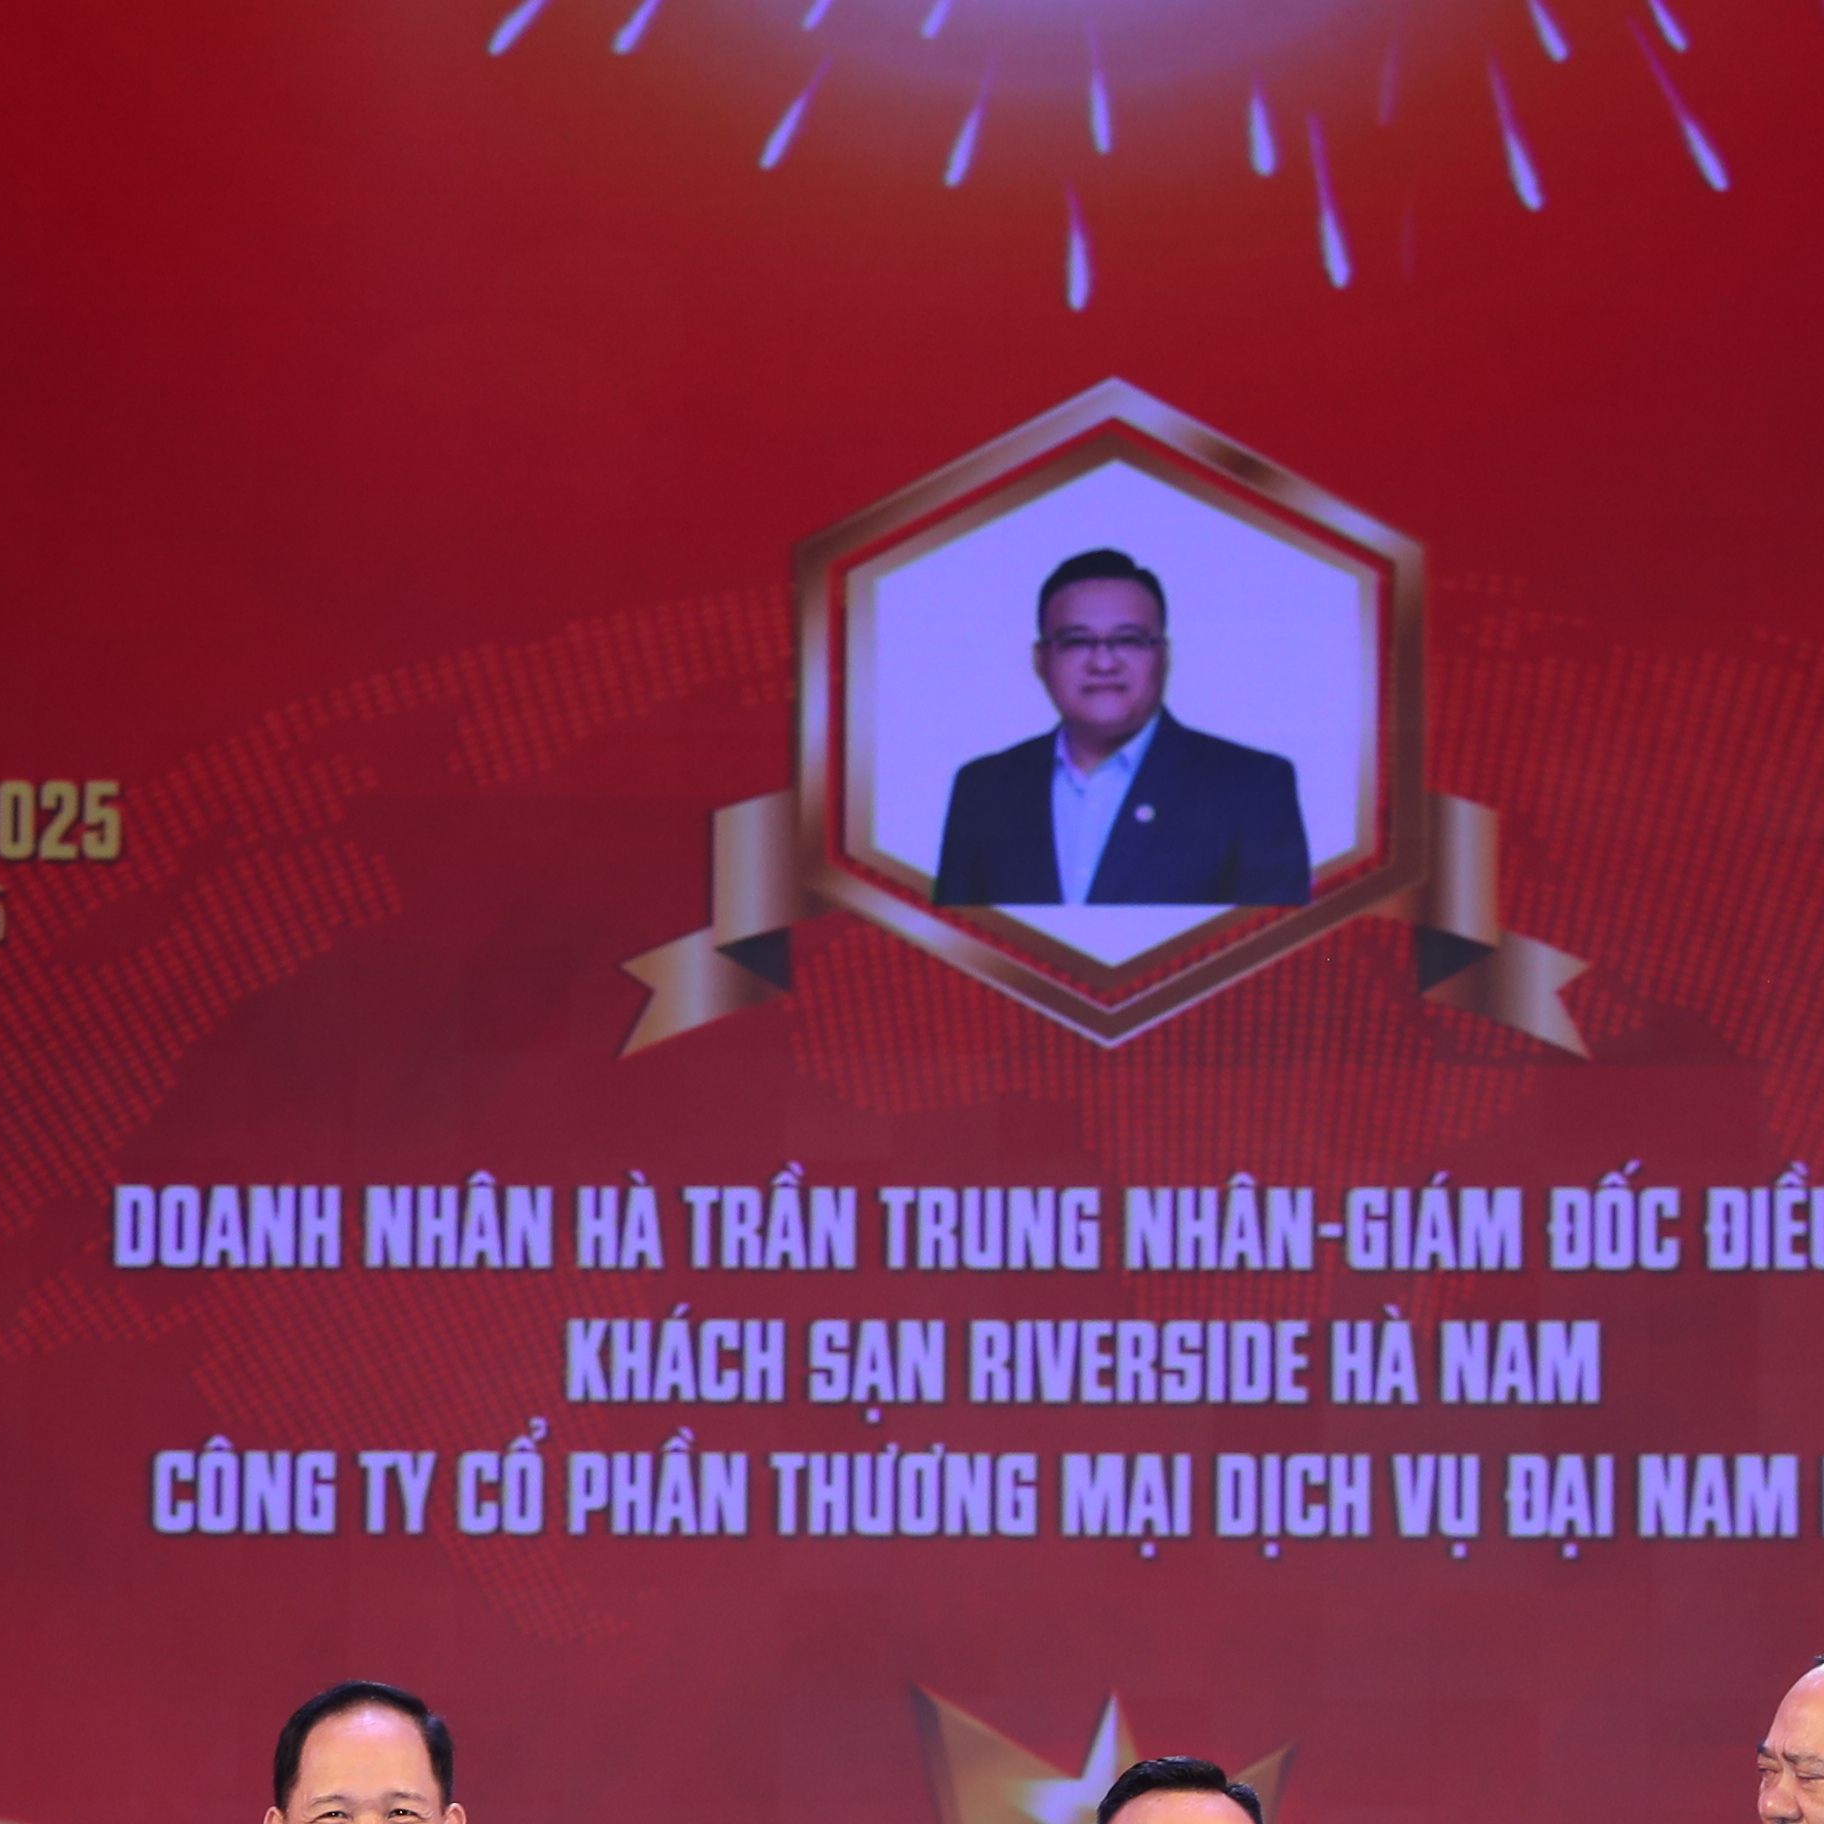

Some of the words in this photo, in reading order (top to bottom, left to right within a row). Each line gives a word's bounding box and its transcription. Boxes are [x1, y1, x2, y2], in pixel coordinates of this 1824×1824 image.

[113, 1185, 341, 1269] DOANH
[365, 1170, 553, 1269] NHÂN
[576, 1170, 663, 1269] HÀ
[684, 1161, 856, 1269] TRẦN
[880, 1186, 1100, 1270] TRUNG
[1125, 1172, 1522, 1270] NHÂN-GIÁM
[1547, 1160, 1680, 1270] ĐỐC
[565, 1303, 785, 1403] KHÁCH
[808, 1320, 945, 1423] SẠN
[969, 1320, 1309, 1403] RIVERSIDE
[1331, 1304, 1418, 1404] HÀ
[1440, 1320, 1601, 1404] NAM
[152, 1434, 336, 1534] CÔNG
[358, 1450, 436, 1534] TY
[457, 1416, 549, 1534] CỔ
[567, 1427, 748, 1535] PHẦN
[771, 1444, 1038, 1536] THƯƠNG
[1061, 1454, 1192, 1558] MẠI
[1216, 1454, 1371, 1558] DỊCH
[1392, 1454, 1480, 1558] VỤ
[1505, 1454, 1614, 1558] ĐẠI
[1638, 1454, 1798, 1538] NAM
